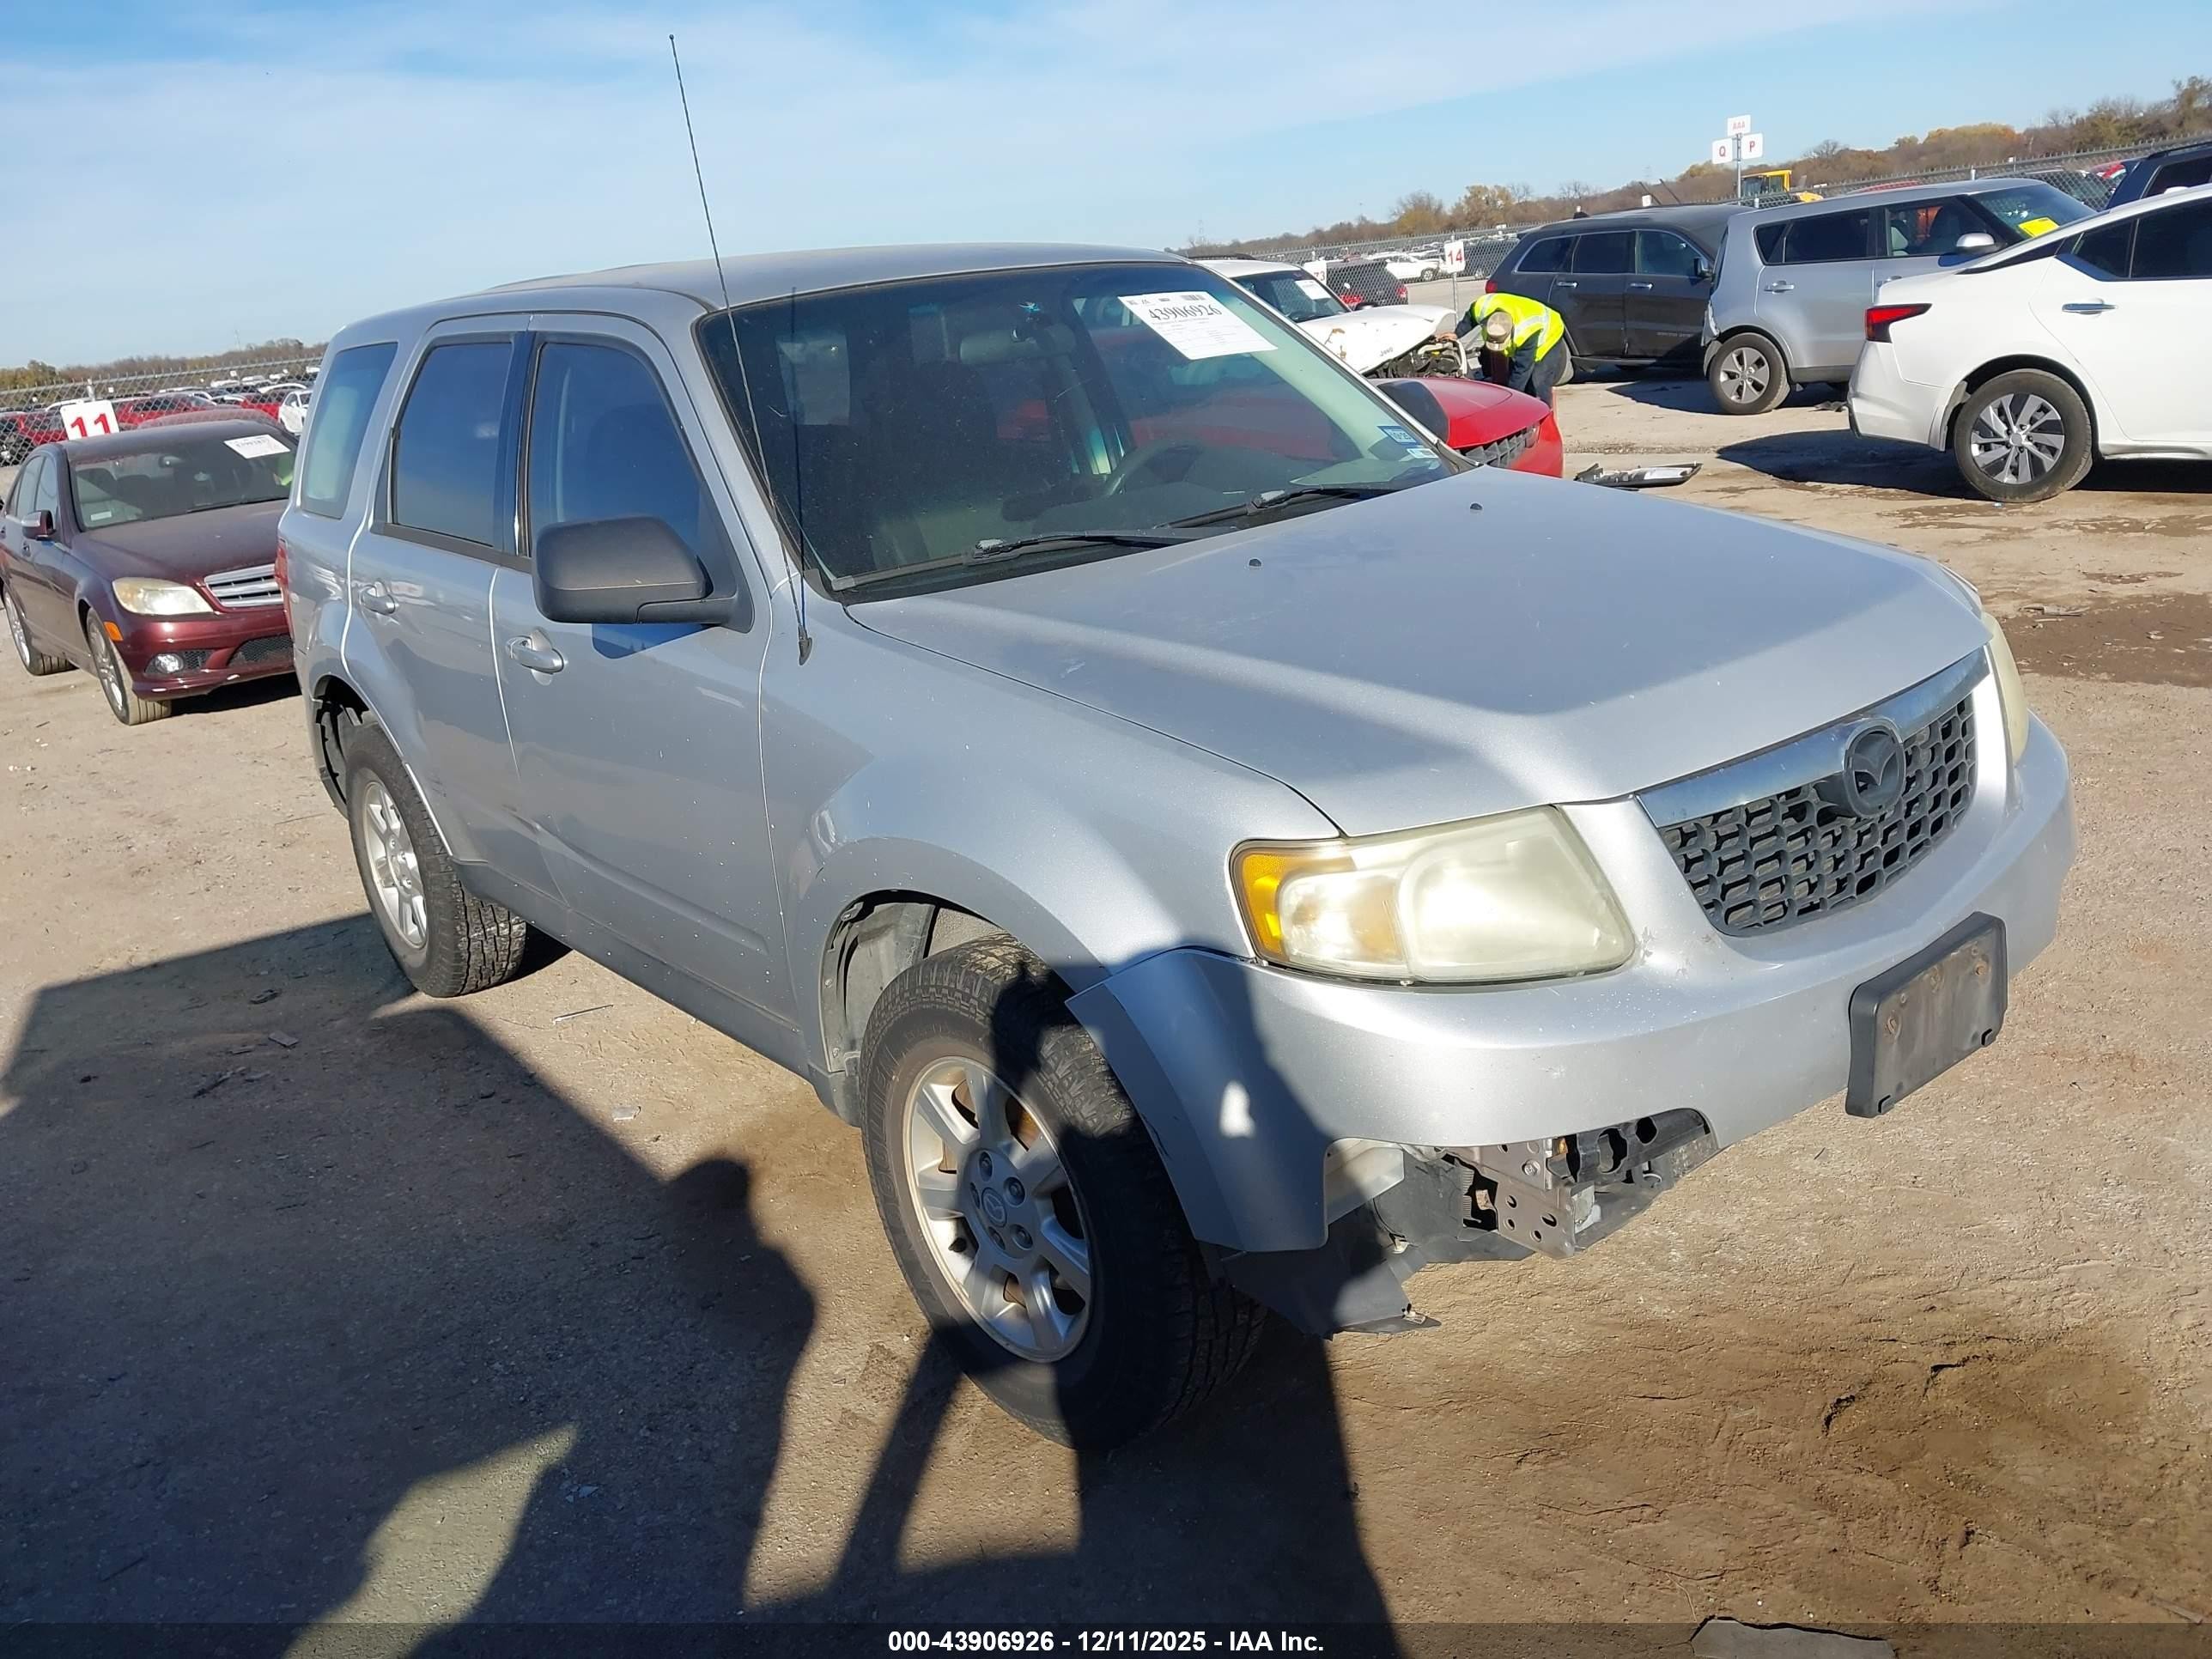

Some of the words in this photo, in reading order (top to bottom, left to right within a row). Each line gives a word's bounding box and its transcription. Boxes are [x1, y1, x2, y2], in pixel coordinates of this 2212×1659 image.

[1719, 146, 1726, 157] Q
[1749, 141, 1755, 152] P
[1448, 249, 1463, 264] 14
[1148, 304, 1223, 320] 43906926
[70, 413, 111, 438] 11
